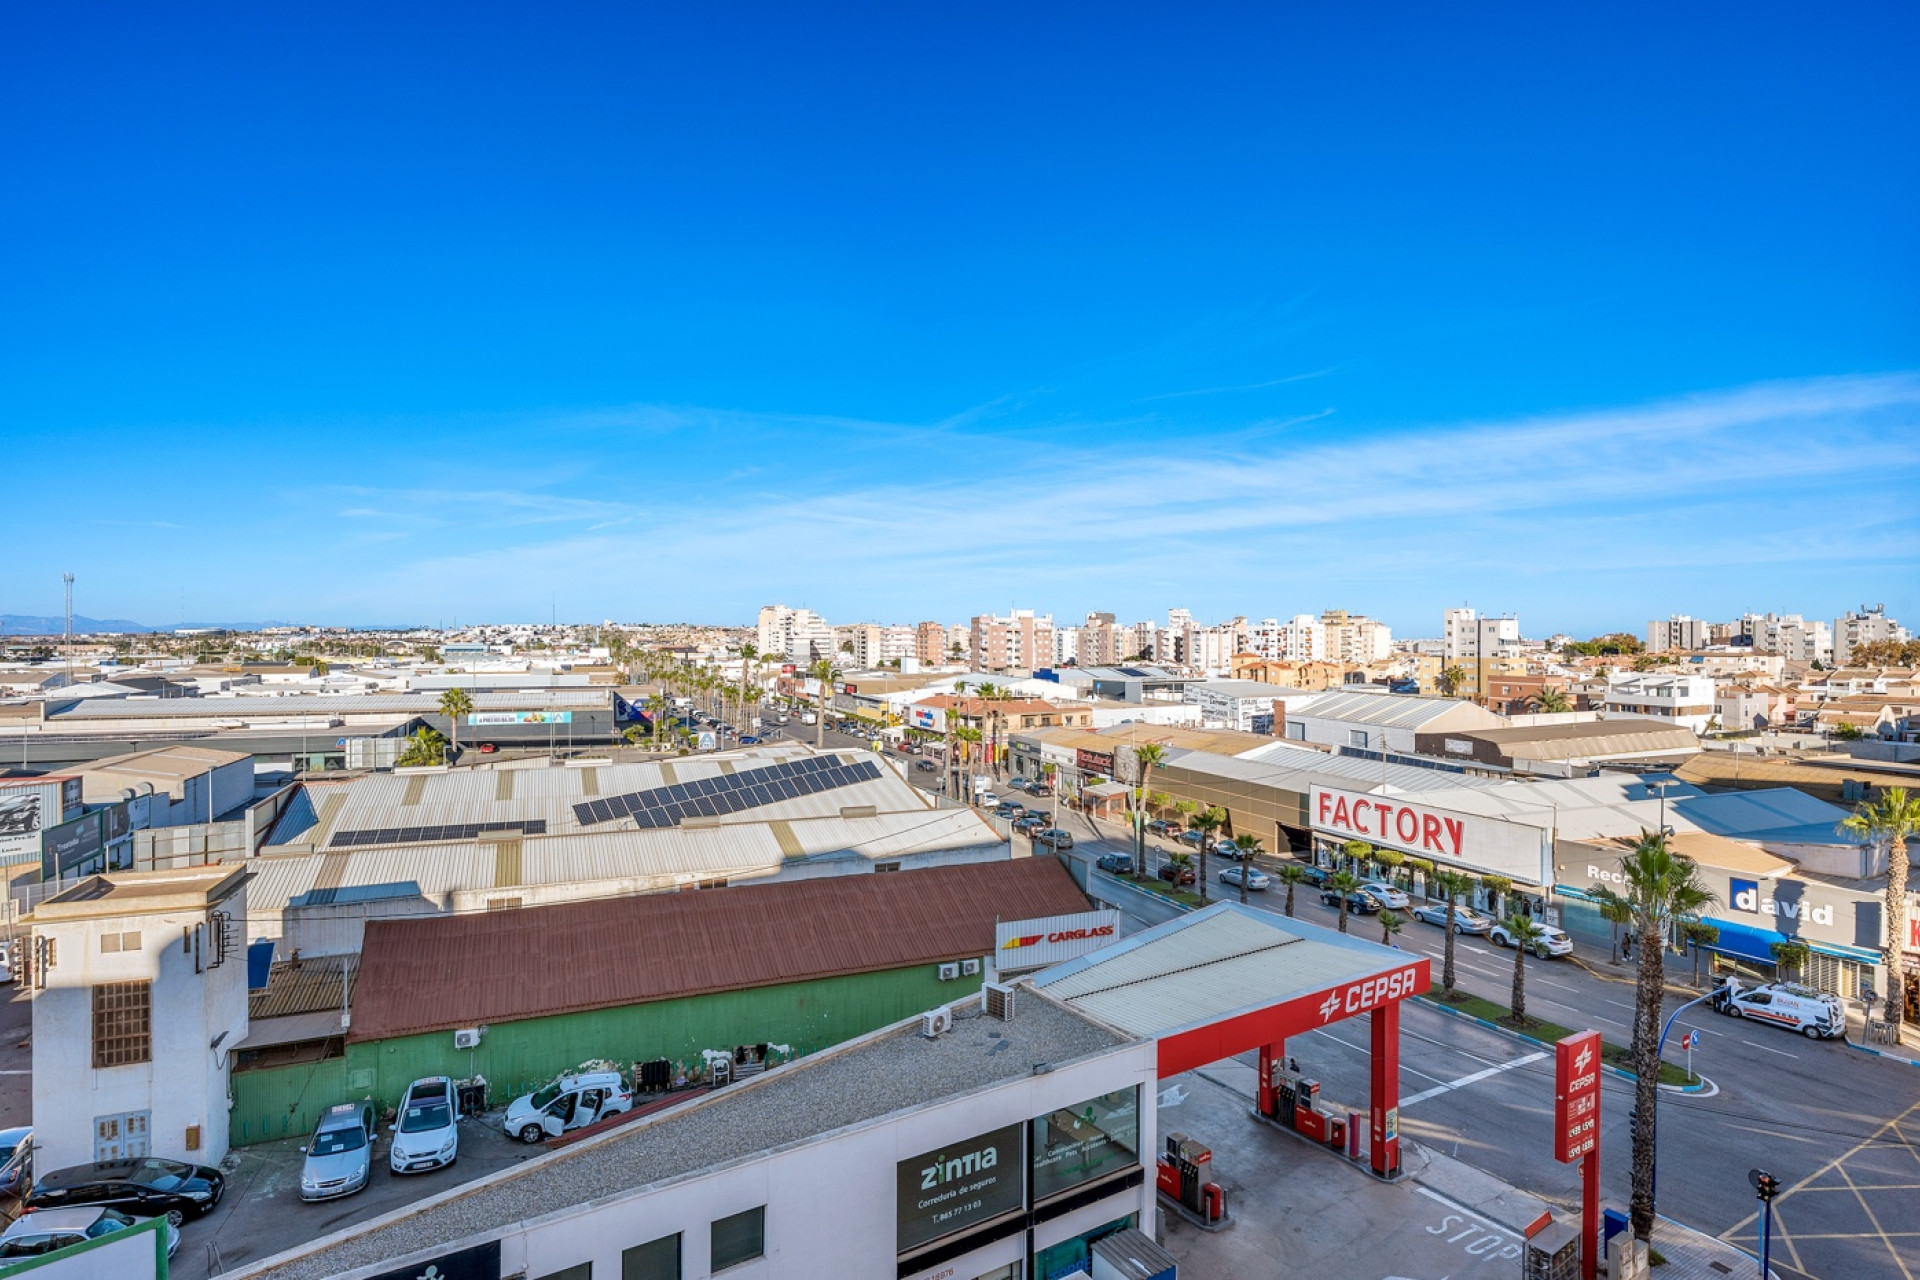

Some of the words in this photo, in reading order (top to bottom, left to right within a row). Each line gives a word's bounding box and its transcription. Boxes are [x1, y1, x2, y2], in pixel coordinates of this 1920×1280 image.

[1319, 792, 1465, 857] FACTORY
[1735, 889, 1834, 927] david
[1047, 924, 1114, 943] CARGLASS
[1345, 967, 1416, 1013] CEPSA
[1569, 1072, 1596, 1093] CEPSA
[1065, 1149, 1078, 1158] Pets
[959, 1186, 968, 1195] de
[969, 1176, 997, 1191] seguros
[1425, 1214, 1523, 1263] STOP
